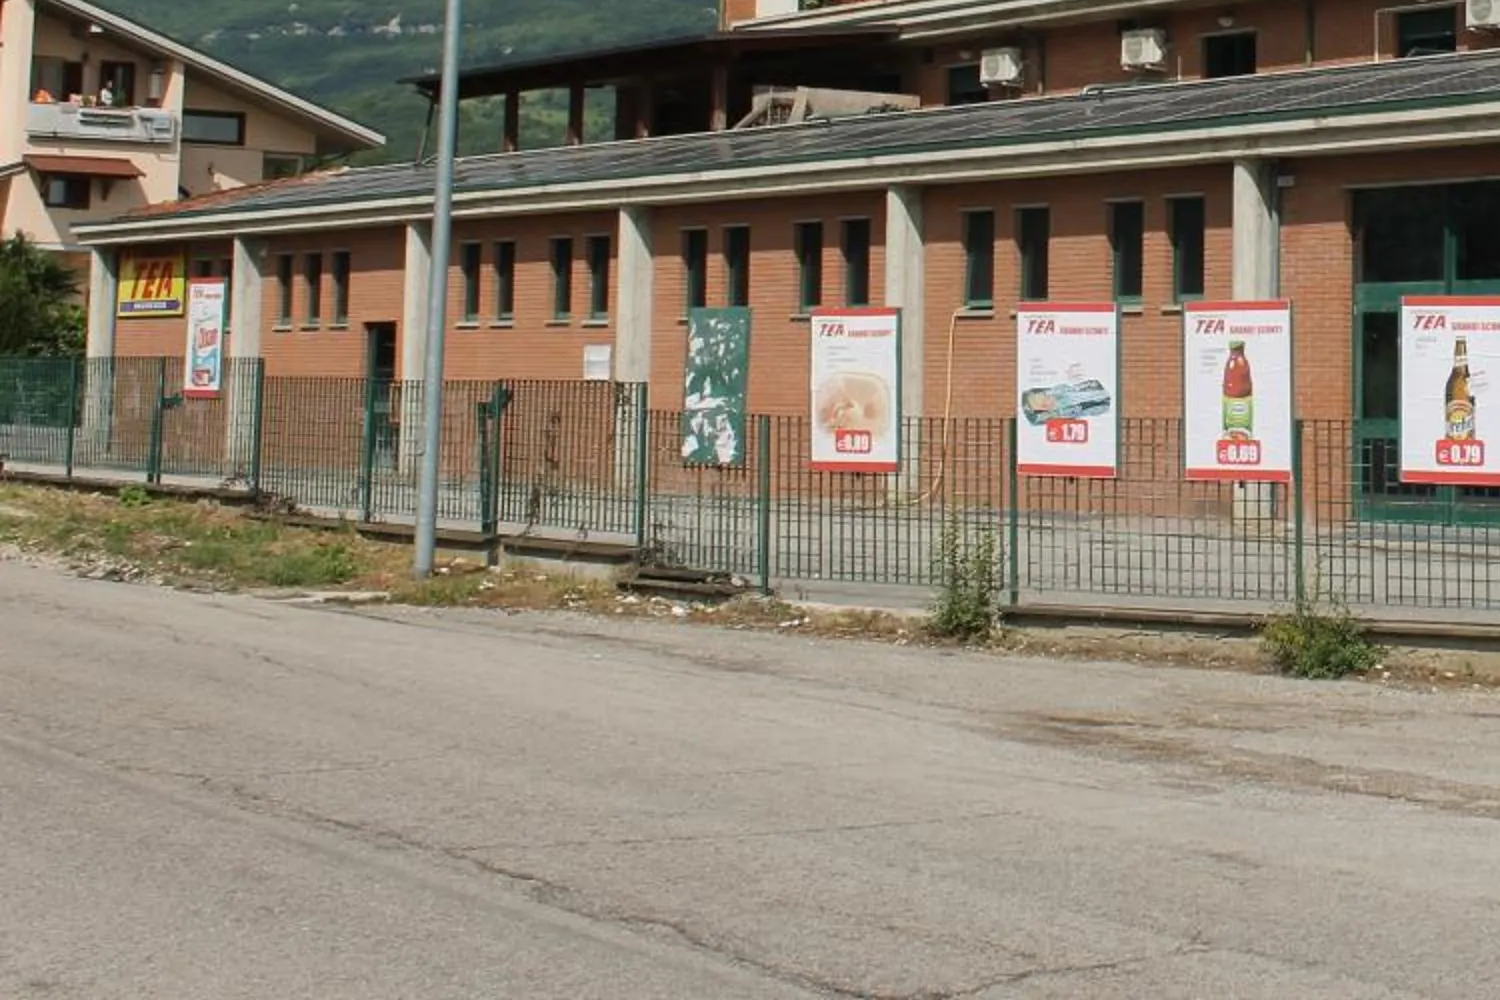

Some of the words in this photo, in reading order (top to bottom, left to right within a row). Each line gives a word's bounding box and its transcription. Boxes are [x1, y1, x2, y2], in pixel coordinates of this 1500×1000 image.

[131, 261, 174, 299] TEA
[1027, 320, 1055, 335] TEA
[1195, 319, 1225, 335] TEA
[1413, 315, 1446, 330] TEA
[820, 324, 844, 337] TEA
